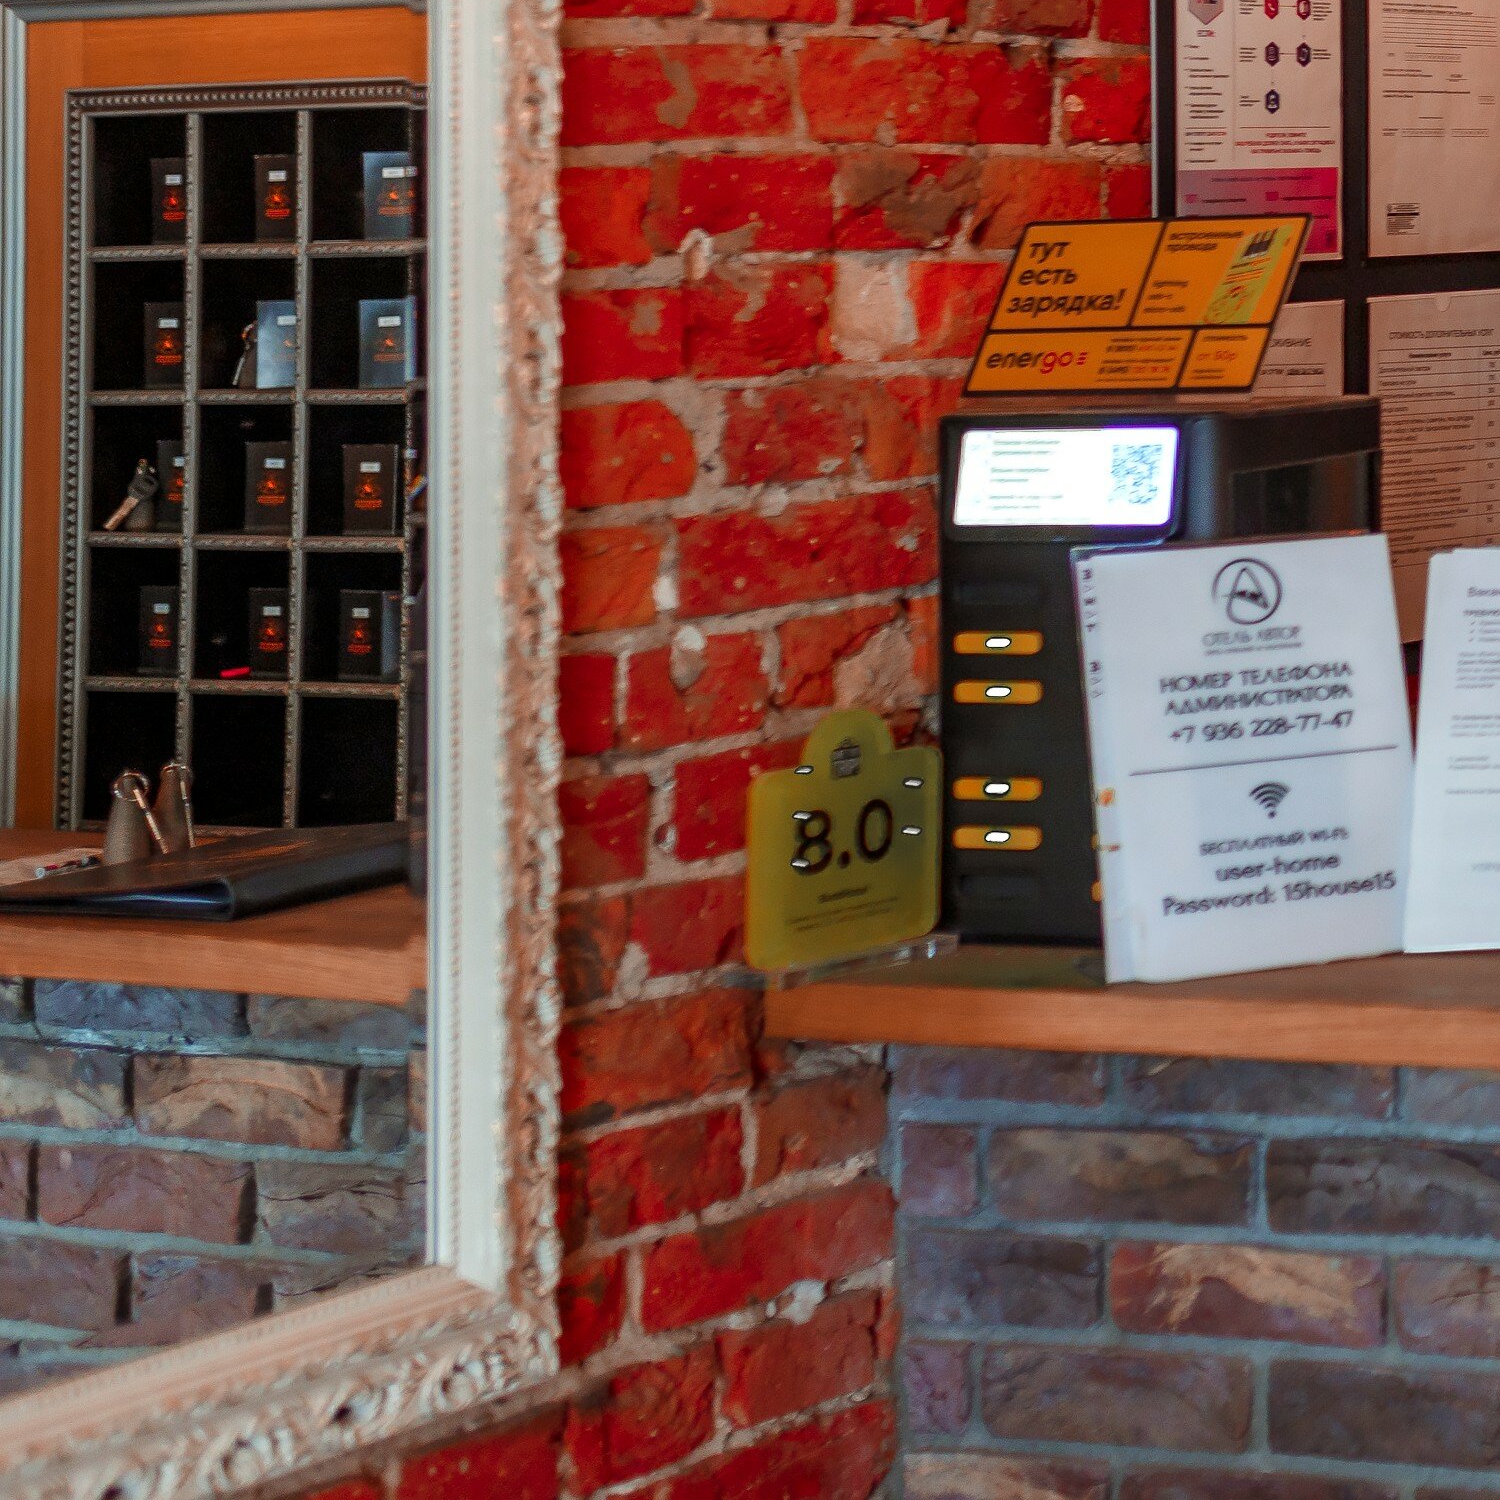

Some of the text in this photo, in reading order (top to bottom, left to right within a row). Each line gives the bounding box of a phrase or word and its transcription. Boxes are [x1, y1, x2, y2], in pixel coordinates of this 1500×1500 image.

[1028, 239, 1071, 263] тут
[1018, 264, 1078, 288] есть
[1006, 288, 1128, 319] зарядка!
[986, 346, 1075, 375] energo
[1159, 660, 1354, 694] НОМЕР ТЕЛЕФОНА
[1164, 683, 1354, 716] АДМИНИСТРАТОРА
[1169, 724, 1195, 744] +7
[793, 798, 894, 875] 8.0
[1215, 853, 1342, 882] user-home
[1162, 871, 1397, 917] Password: 15house15
